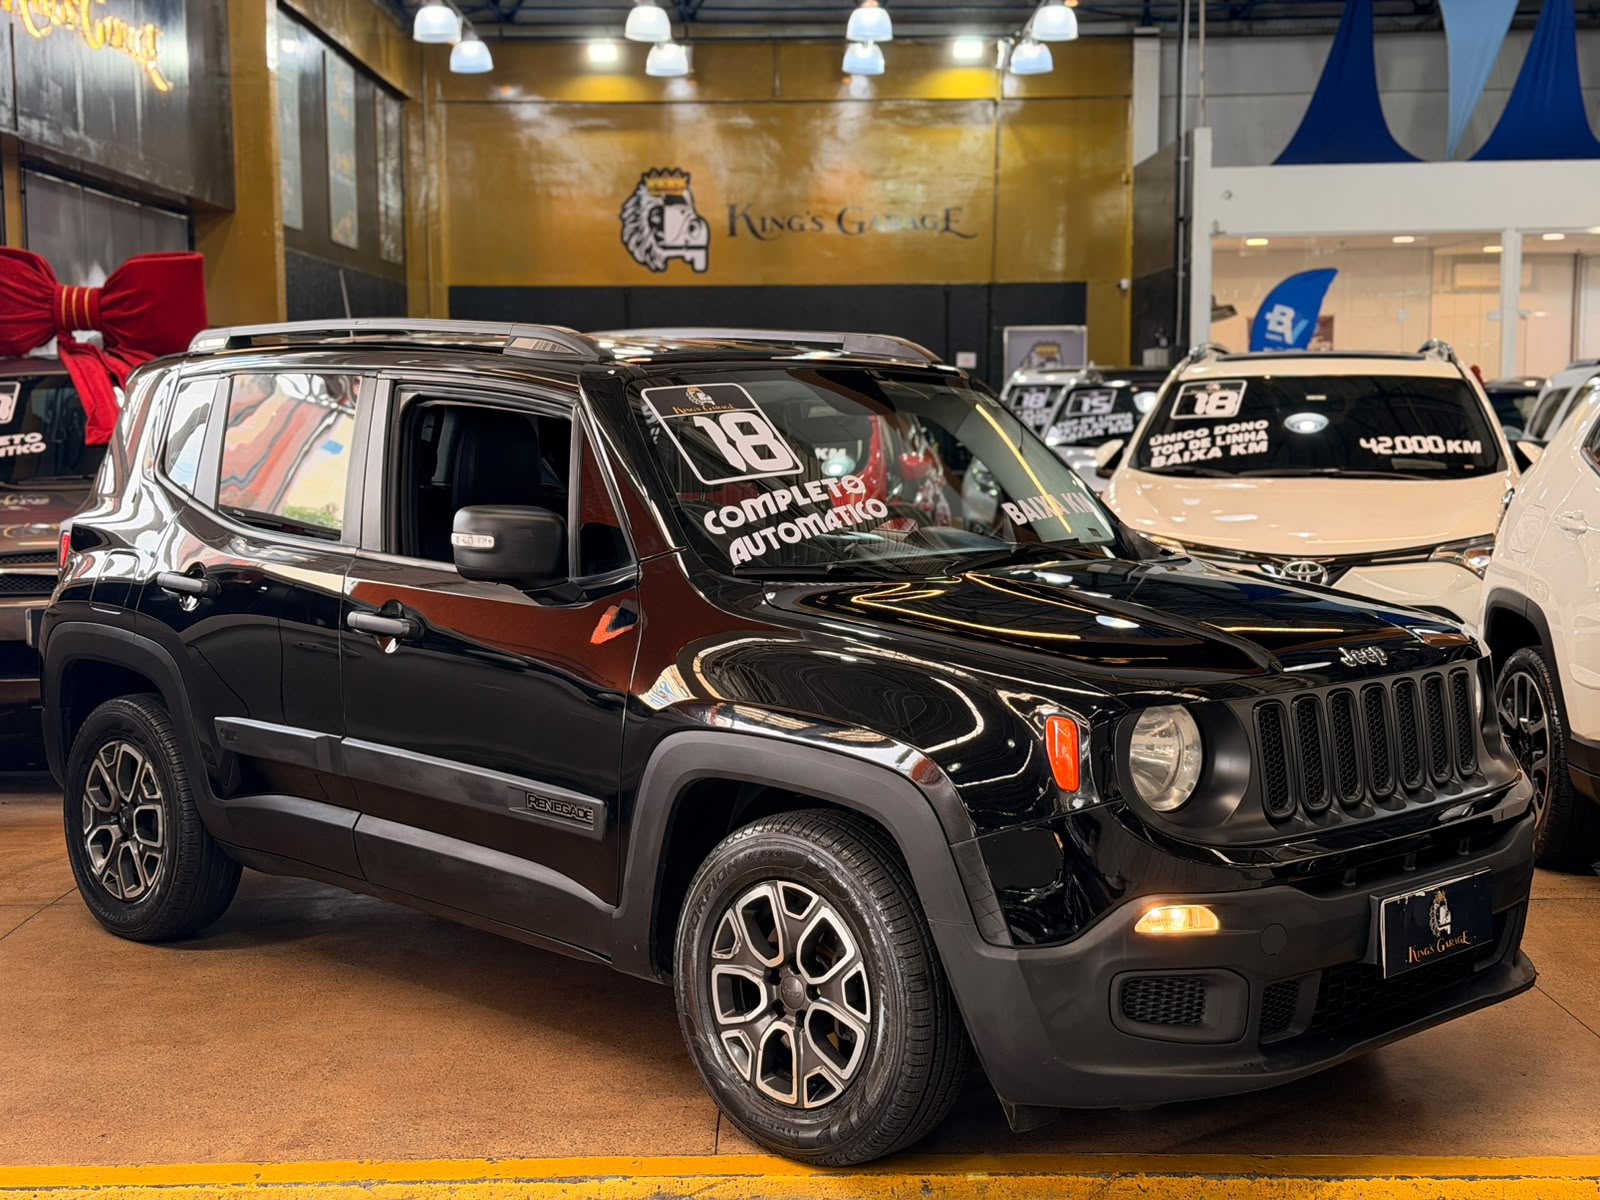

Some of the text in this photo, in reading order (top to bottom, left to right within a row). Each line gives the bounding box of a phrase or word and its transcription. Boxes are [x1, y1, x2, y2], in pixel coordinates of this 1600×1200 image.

[1194, 390, 1239, 416] 18
[1213, 419, 1269, 435] DONO
[693, 411, 794, 473] 18
[1150, 430, 1269, 457] TOP DE LINHA
[1150, 440, 1269, 468] BAIXA KM
[1446, 440, 1482, 454] KM
[703, 474, 867, 536] COMPLETO
[1001, 494, 1071, 526] BAIXA
[729, 498, 889, 566] AUTOMATICO
[1338, 645, 1388, 667] Jeep
[527, 792, 594, 824] RENEGADE
